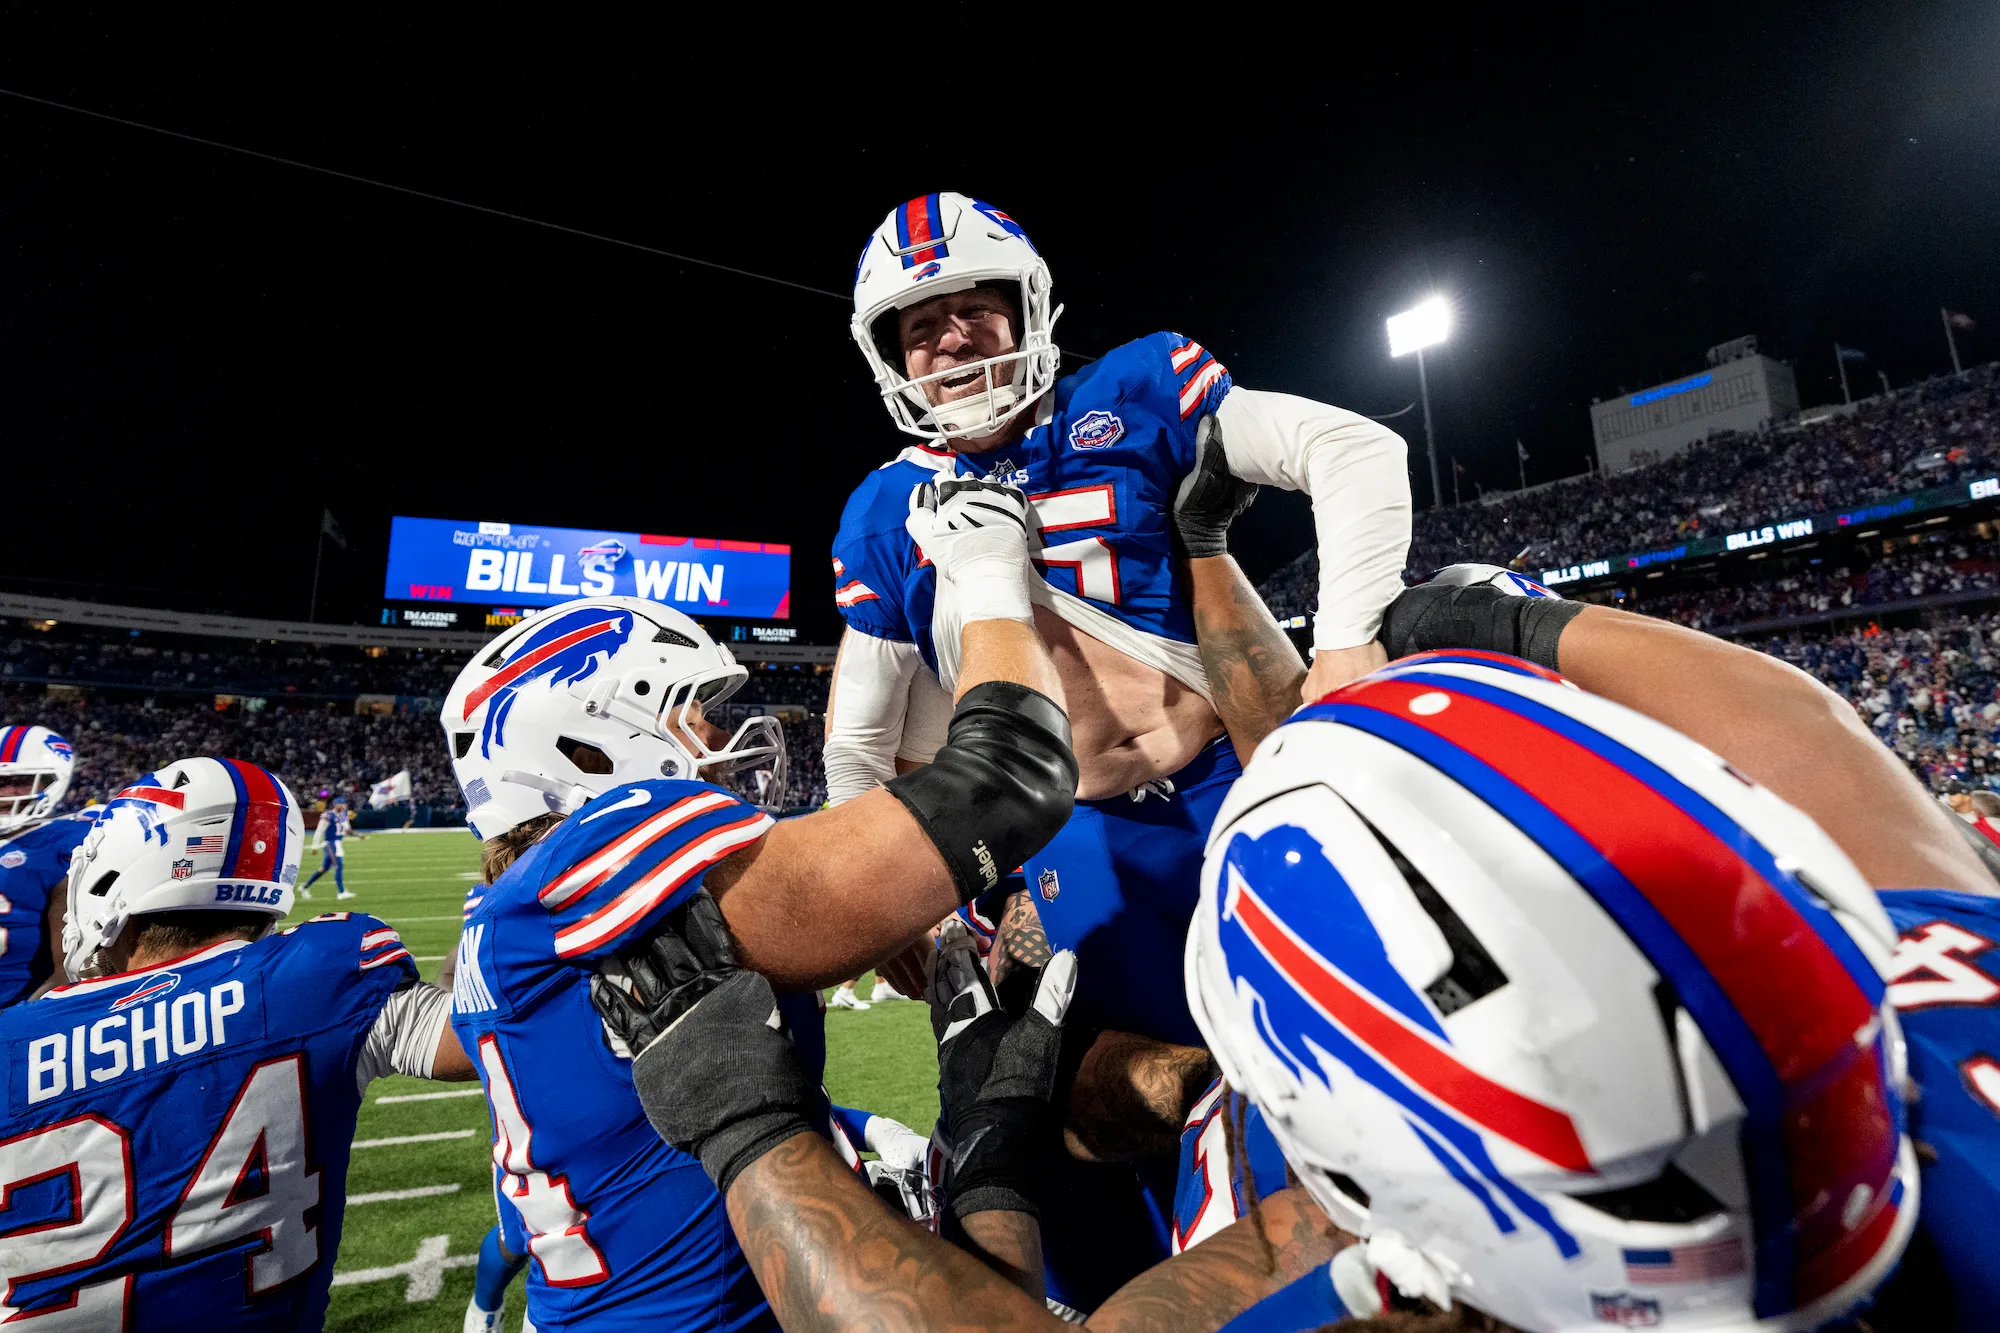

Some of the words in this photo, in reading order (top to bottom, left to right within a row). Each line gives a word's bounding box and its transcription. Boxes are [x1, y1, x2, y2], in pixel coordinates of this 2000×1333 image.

[1026, 483, 1122, 606] 5
[1726, 526, 1776, 551] BILLS
[1777, 518, 1814, 540] WIN
[465, 548, 616, 597] BILLS
[633, 558, 725, 604] WIN
[1542, 565, 1581, 586] BILLS
[1582, 559, 1610, 579] WIN
[410, 583, 453, 600] WIN
[403, 610, 459, 623] IMAGINE
[752, 627, 798, 638] IMAGINE
[173, 867, 191, 879] NFL
[215, 884, 283, 906] BILLS
[27, 978, 247, 1106] BISHOP
[0, 1051, 325, 1333] 24
